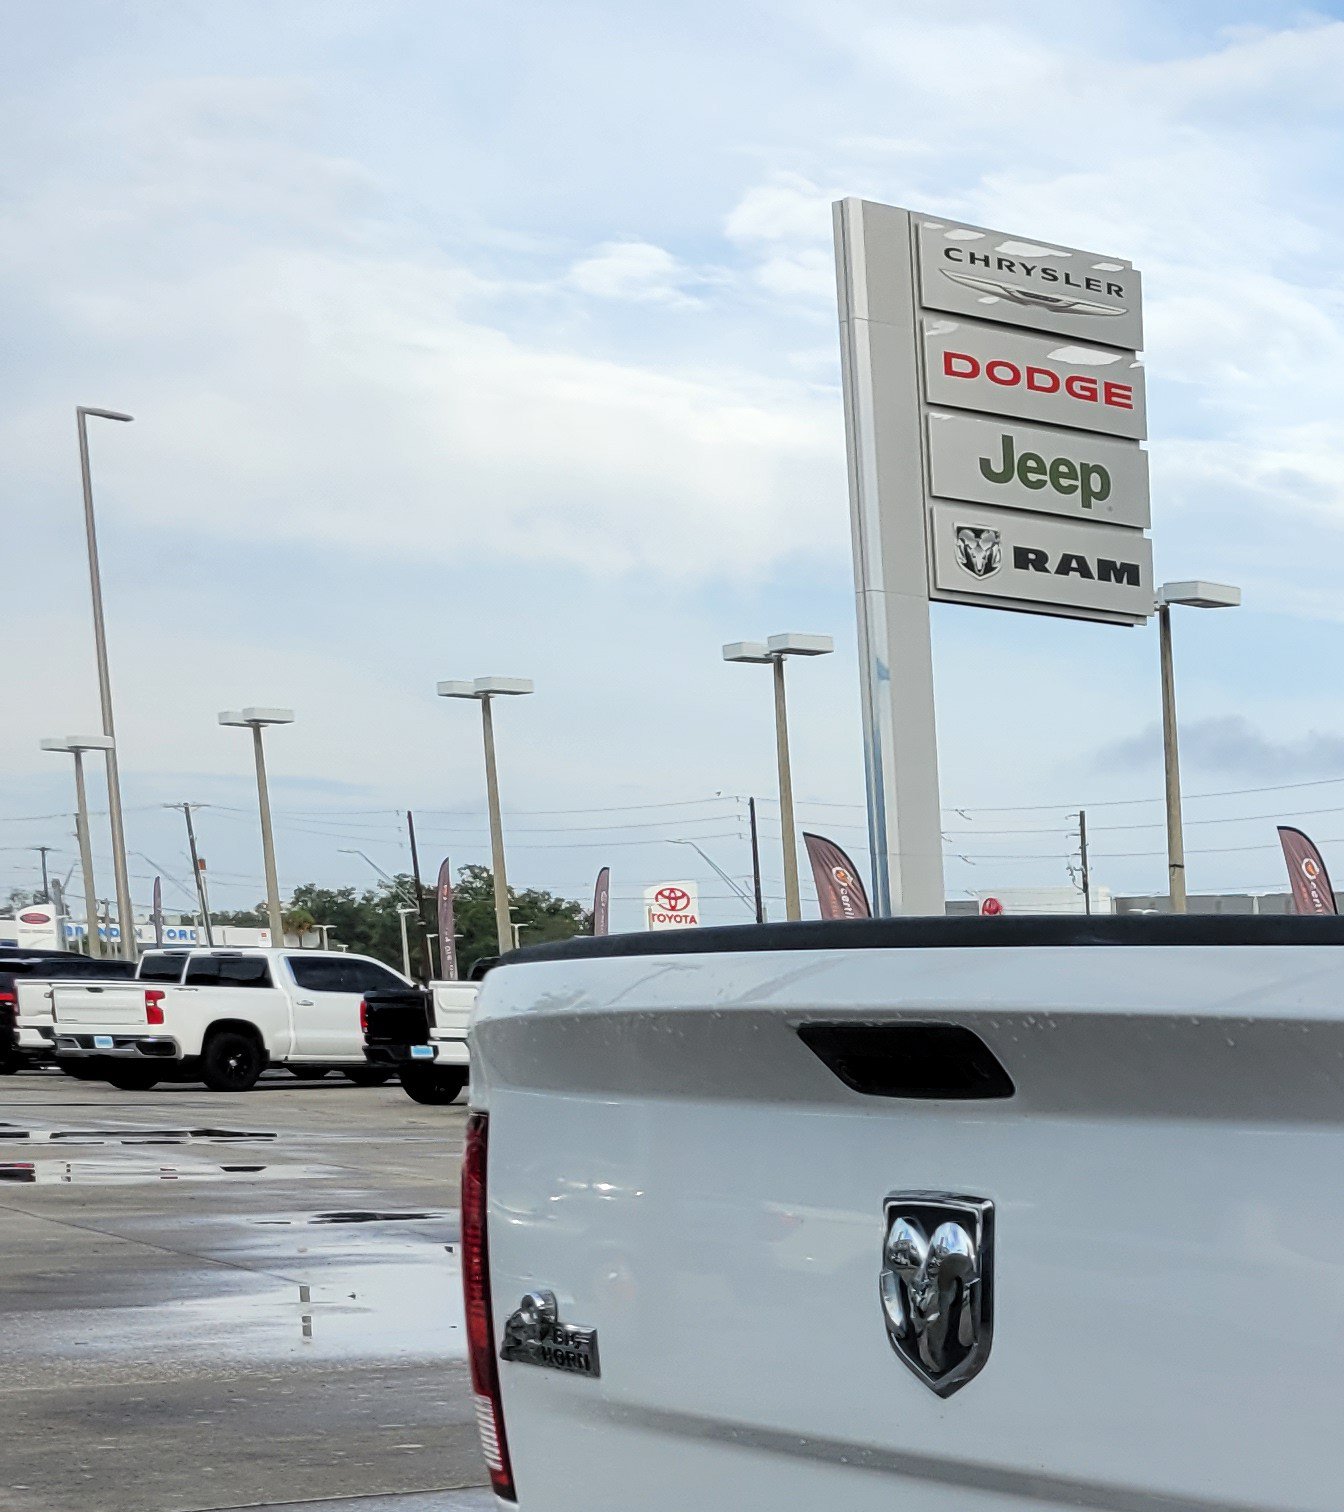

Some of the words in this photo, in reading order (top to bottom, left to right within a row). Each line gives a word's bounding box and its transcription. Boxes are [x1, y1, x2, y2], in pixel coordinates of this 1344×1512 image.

[943, 247, 1125, 298] CHRYSLER
[943, 351, 1134, 410] DODGE
[979, 434, 1111, 509] Jeep
[1013, 545, 1141, 587] RAM
[651, 913, 697, 925] TOYOTA
